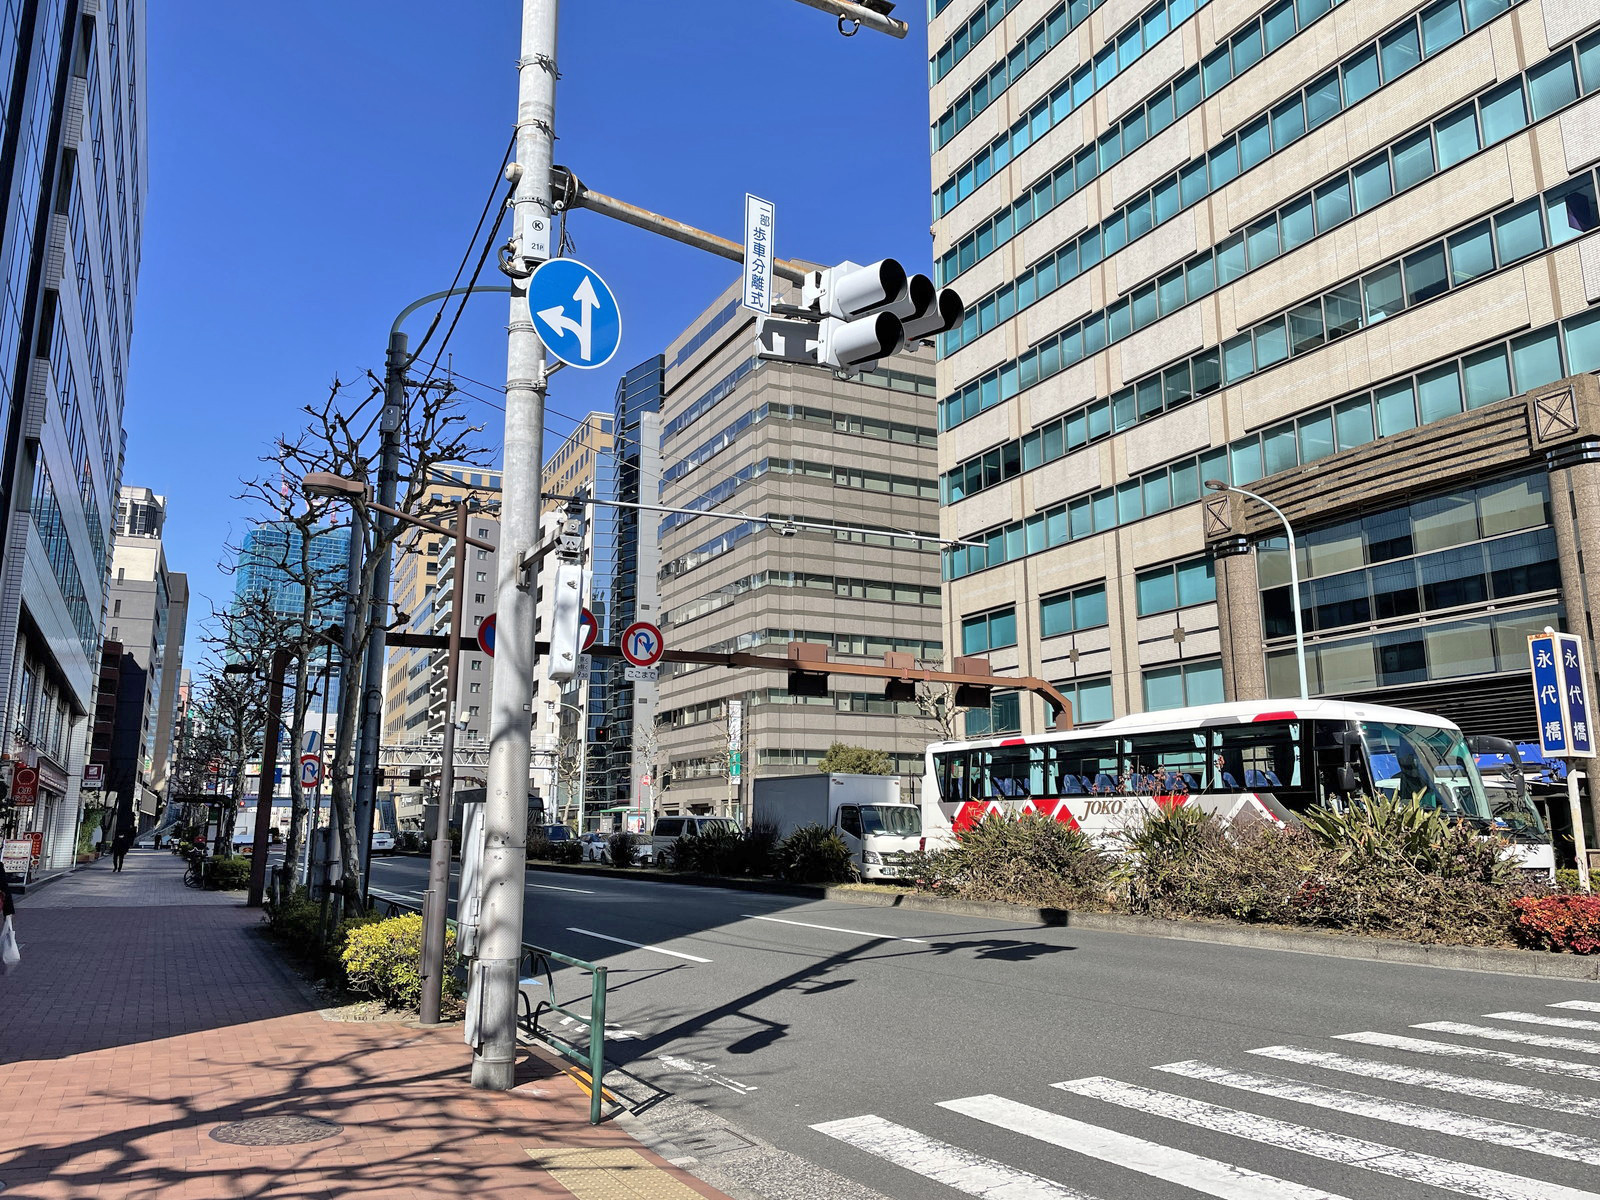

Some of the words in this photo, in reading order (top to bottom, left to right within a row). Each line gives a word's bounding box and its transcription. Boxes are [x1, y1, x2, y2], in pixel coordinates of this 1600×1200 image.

[751, 206, 770, 308] 一部歩車分離式
[627, 670, 656, 679] ここまで
[1536, 649, 1562, 742] 永代橋
[1564, 648, 1587, 742] 永代橋
[1077, 799, 1123, 822] JOKO
